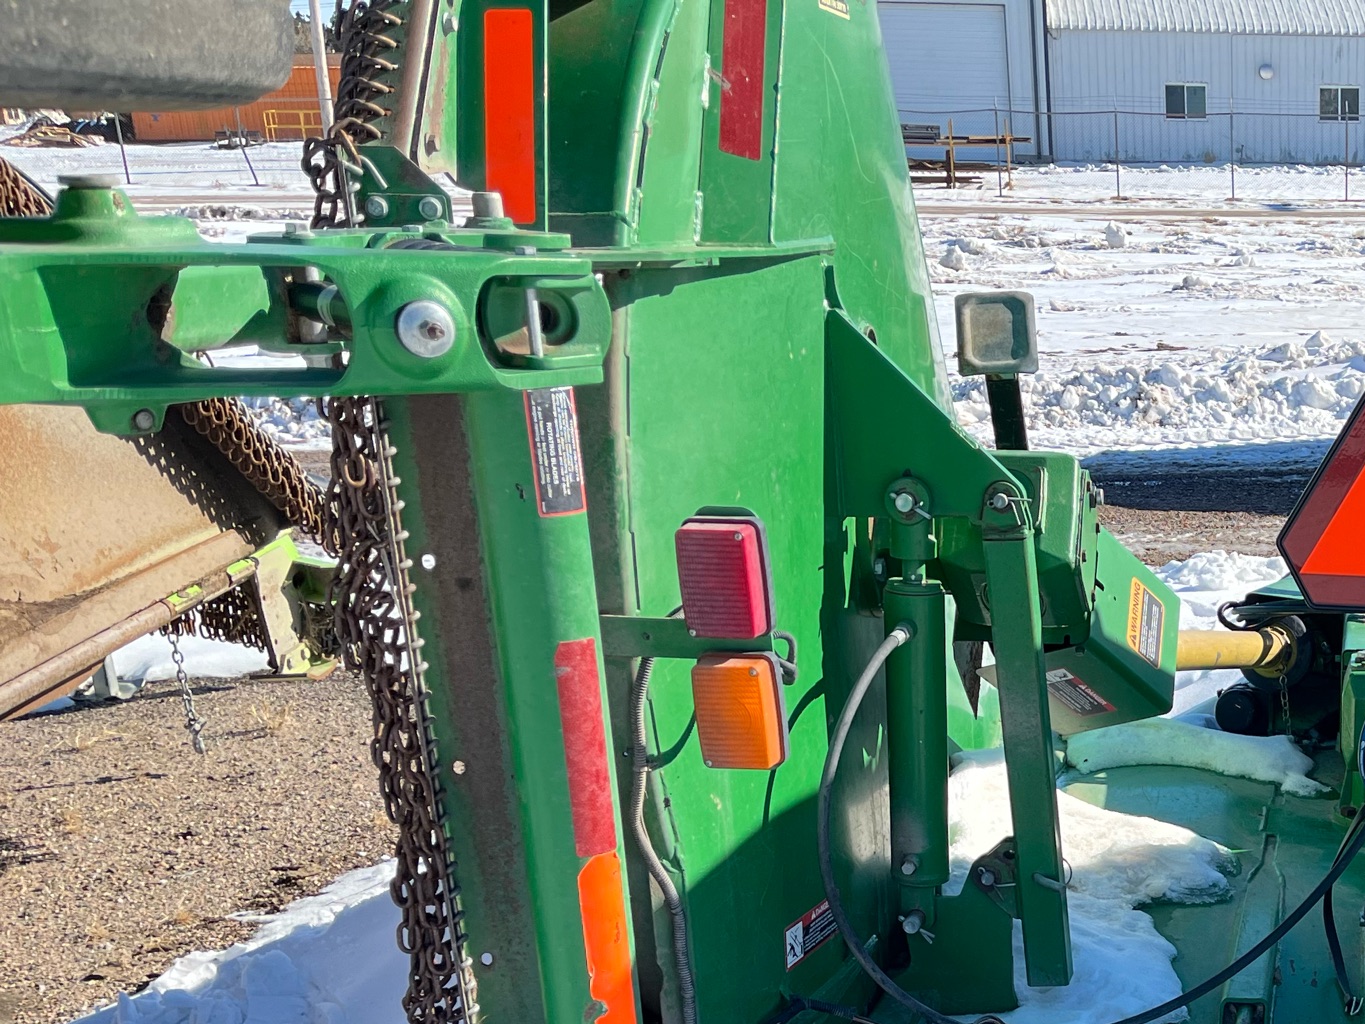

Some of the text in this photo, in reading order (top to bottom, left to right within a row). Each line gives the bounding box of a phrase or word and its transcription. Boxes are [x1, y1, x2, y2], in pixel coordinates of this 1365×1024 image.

[545, 422, 559, 484] ROTATING BLADES
[1131, 582, 1140, 632] WARNING
